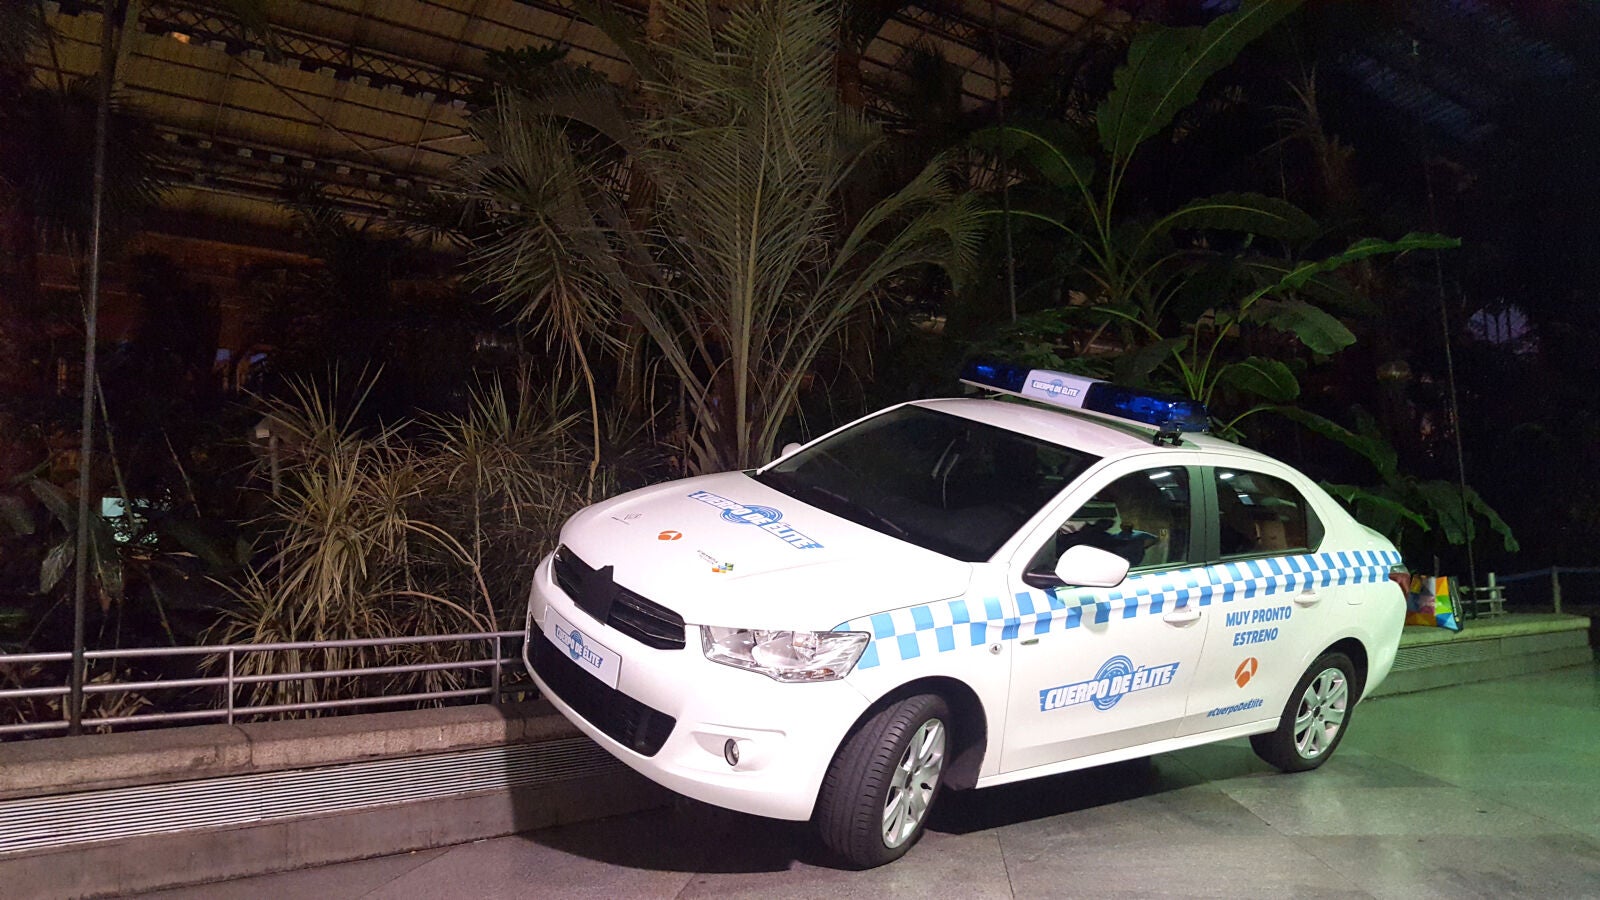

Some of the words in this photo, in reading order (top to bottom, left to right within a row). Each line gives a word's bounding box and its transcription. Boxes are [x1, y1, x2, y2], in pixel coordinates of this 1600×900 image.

[1033, 380, 1054, 392] CUERPO
[1053, 385, 1062, 393] DE
[692, 491, 752, 516] CUERPO
[1225, 610, 1251, 627] MUY
[1251, 605, 1292, 624] PRONTO
[557, 628, 576, 650] CUERPO
[574, 641, 583, 656] DE
[1232, 627, 1279, 646] ESTRENO
[1043, 679, 1109, 710] CUERPO
[1109, 673, 1133, 697] DE
